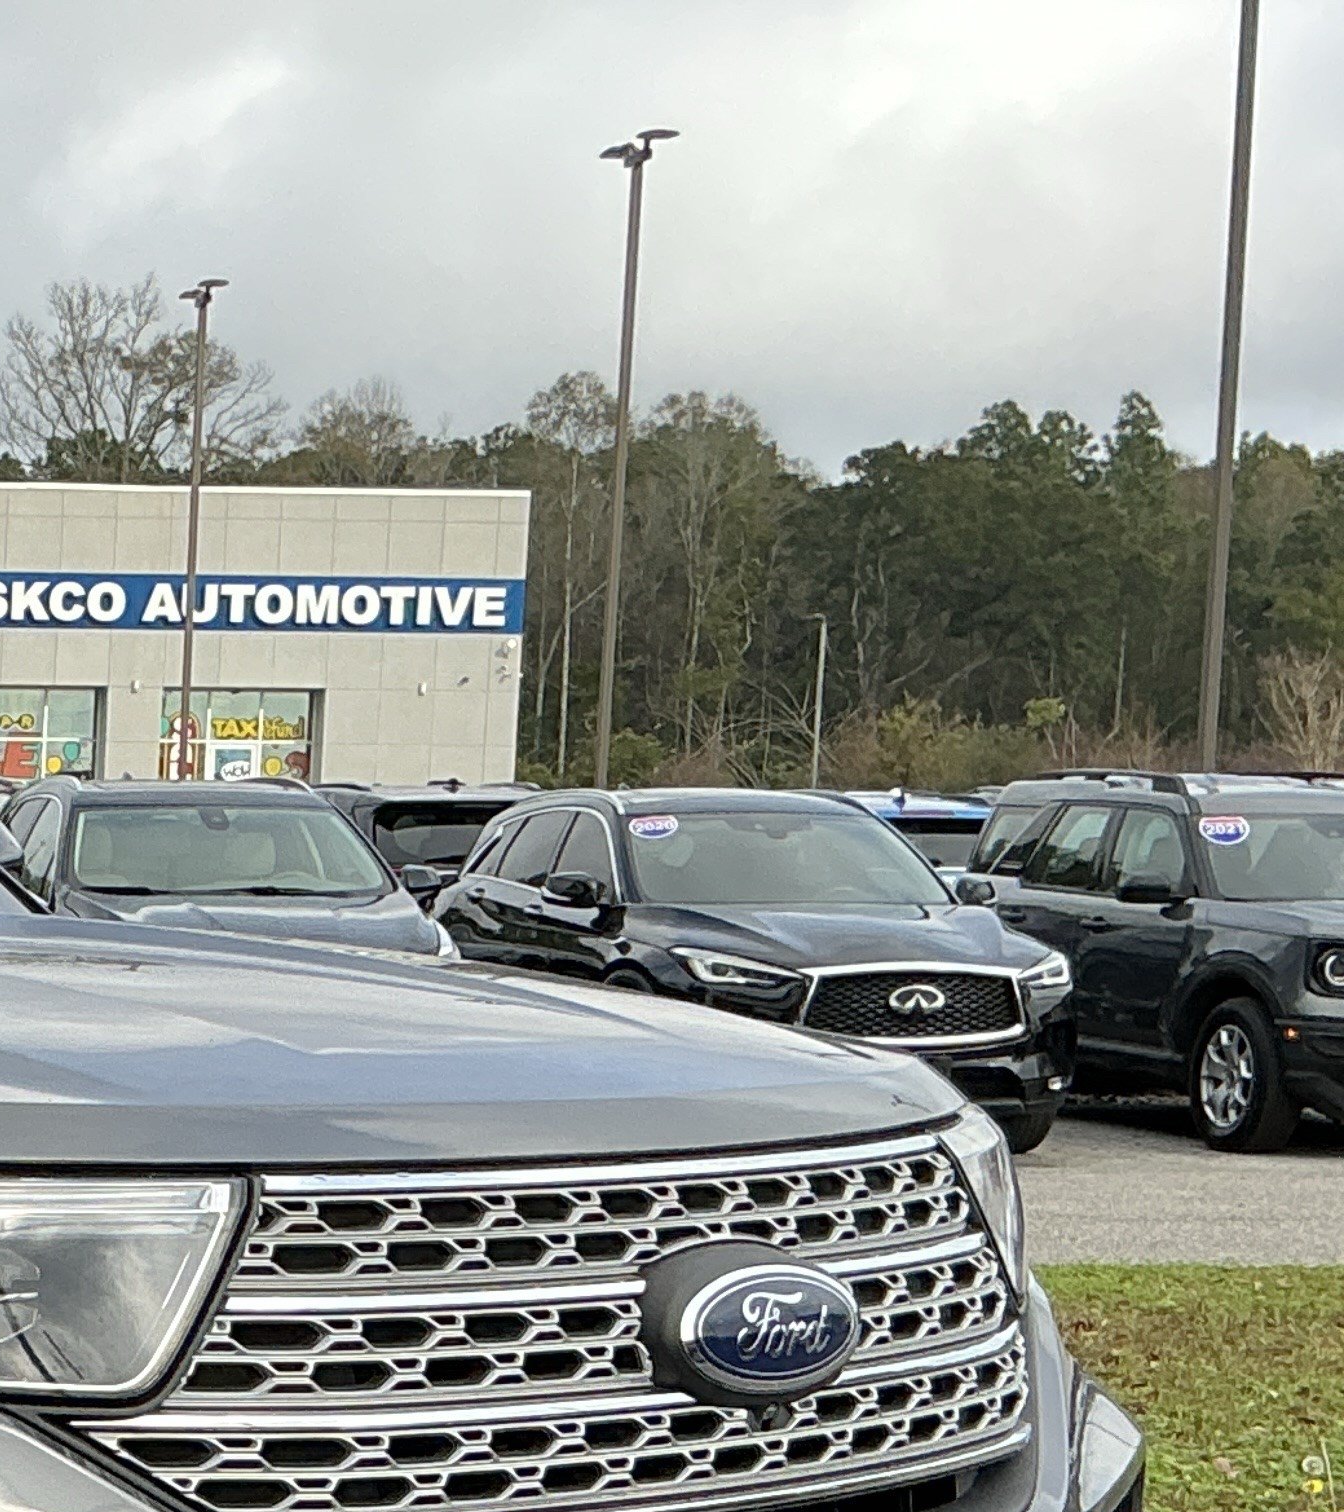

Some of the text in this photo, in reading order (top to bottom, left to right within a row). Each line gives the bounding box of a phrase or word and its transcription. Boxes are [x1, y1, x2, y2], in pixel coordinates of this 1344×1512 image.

[141, 583, 507, 627] AUTOMOTIVE
[211, 717, 258, 738] TAX
[737, 1291, 831, 1362] Ford
